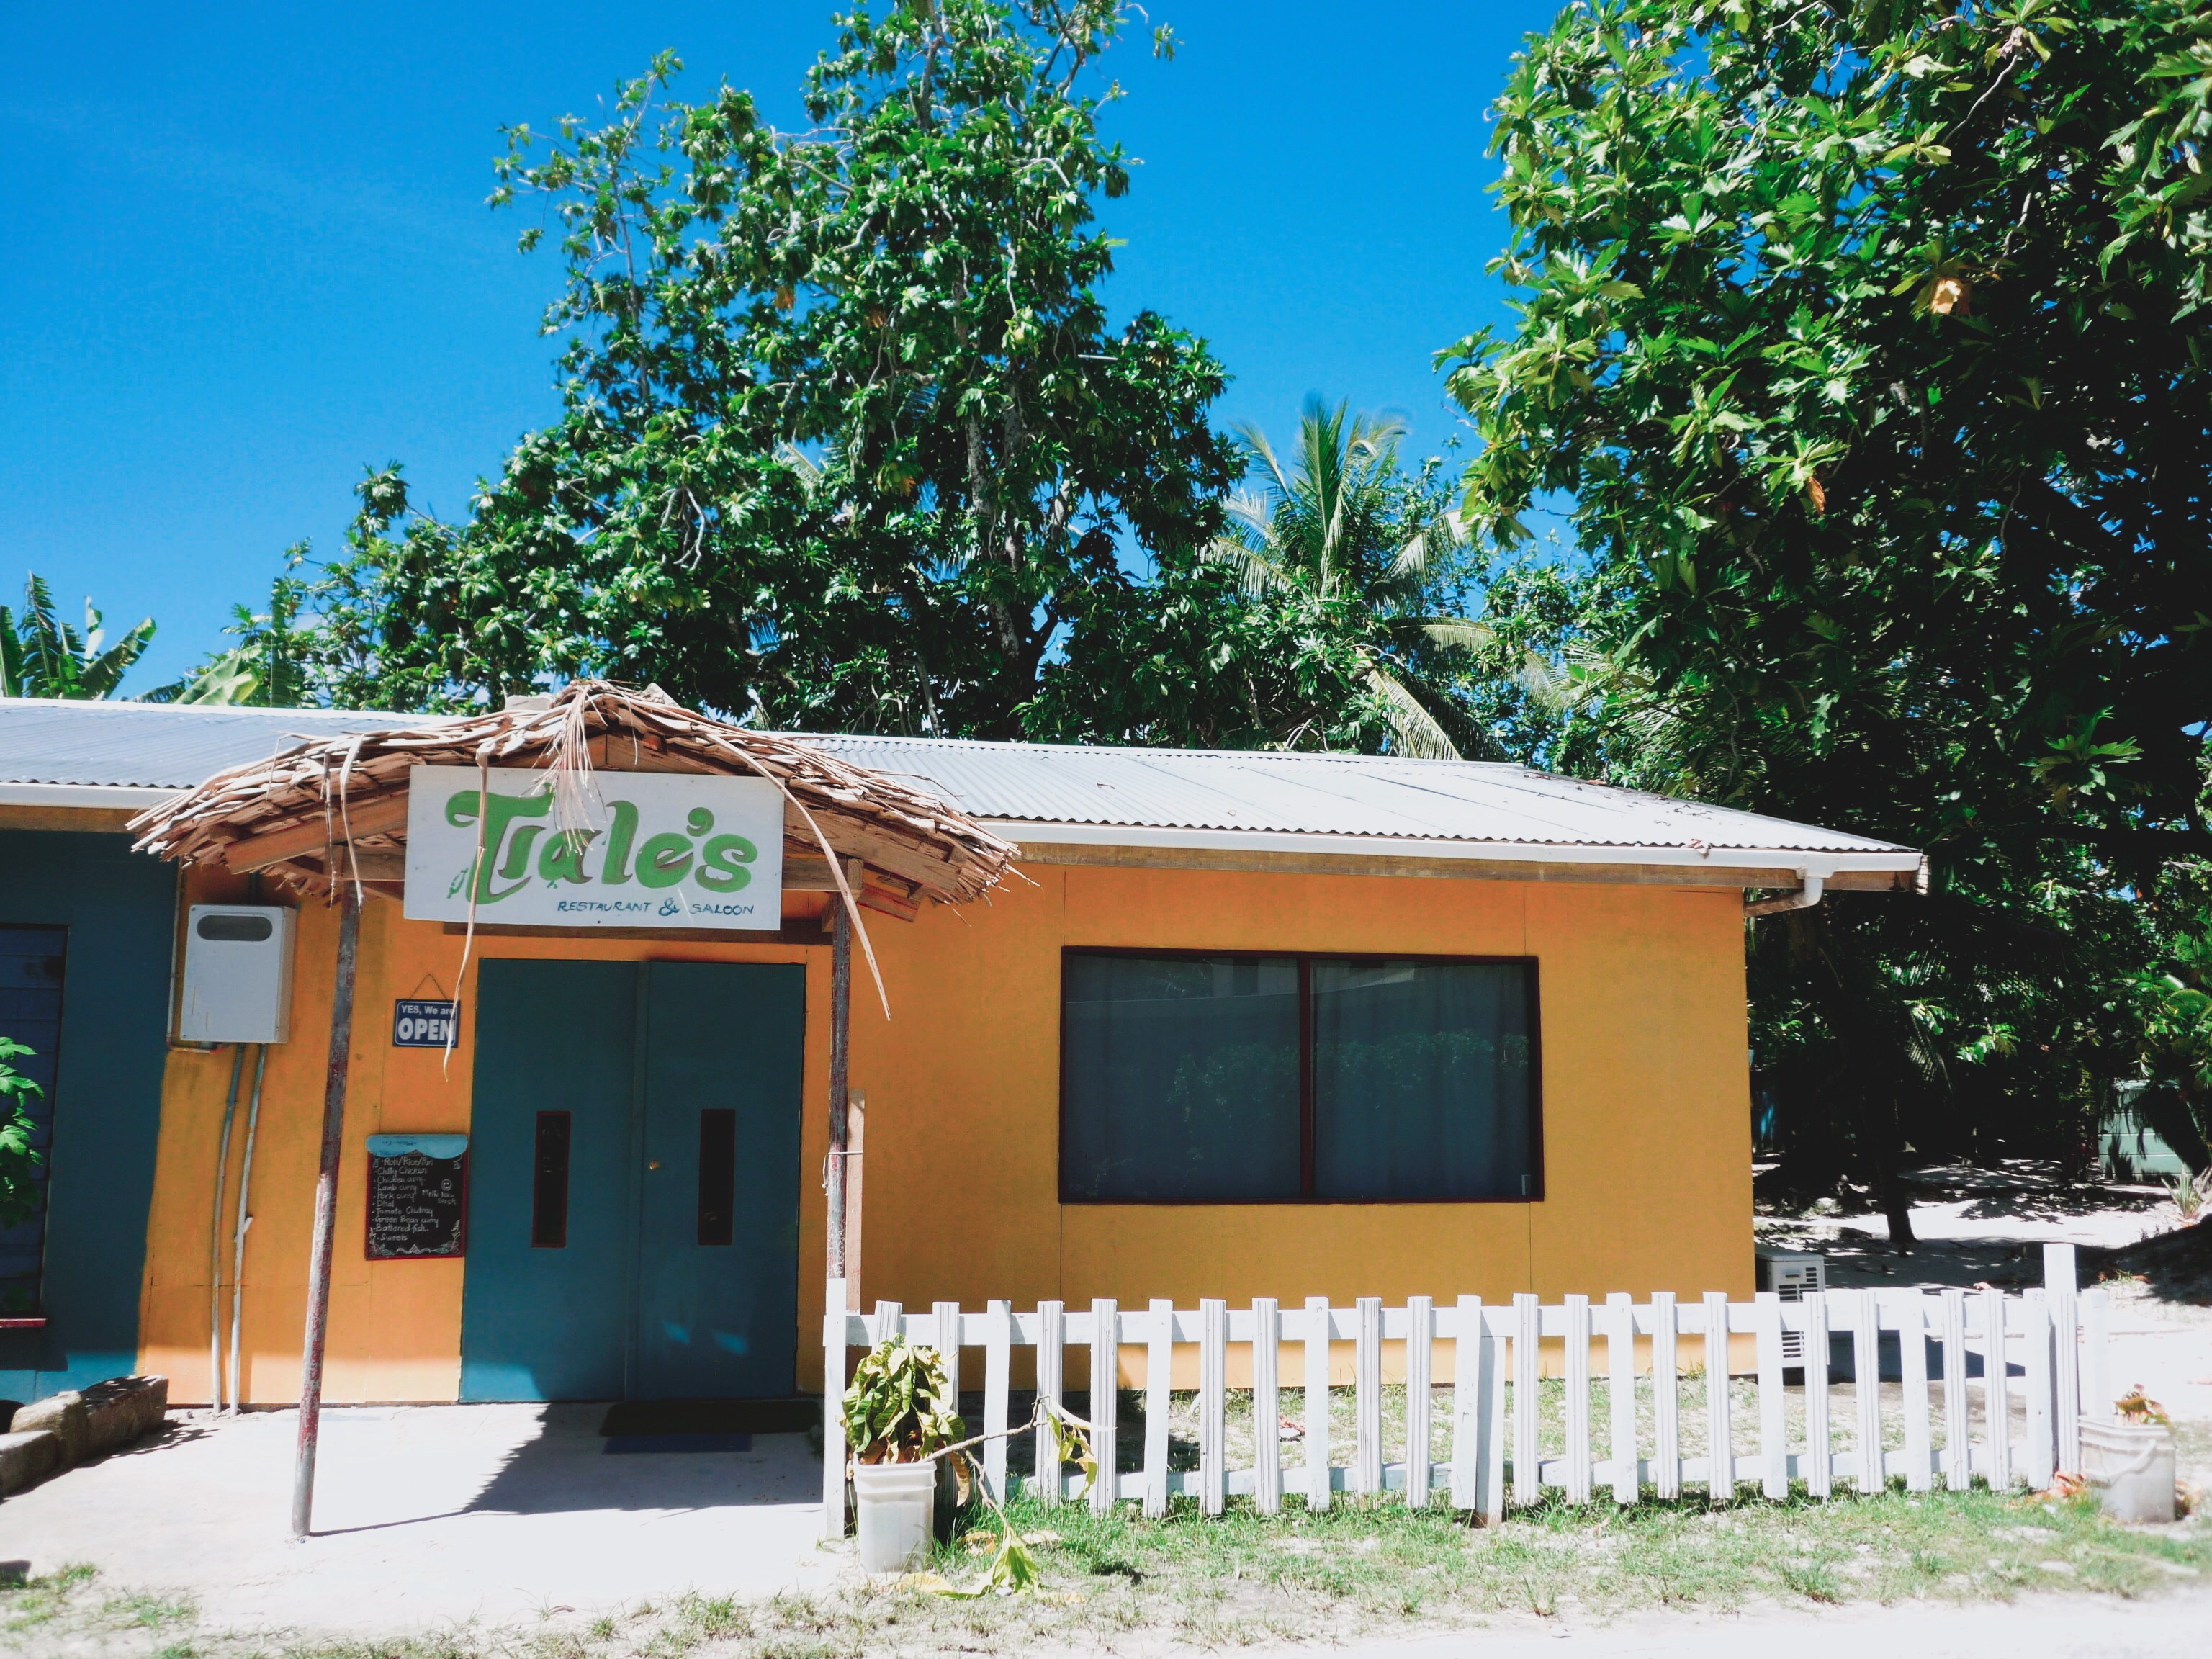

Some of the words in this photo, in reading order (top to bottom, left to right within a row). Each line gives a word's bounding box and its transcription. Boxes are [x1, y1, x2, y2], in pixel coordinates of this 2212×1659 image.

[557, 901, 652, 912] RESTAURANT
[658, 897, 681, 917] &
[688, 904, 755, 916] SALOON
[401, 1005, 422, 1015] YES,
[424, 1006, 439, 1015] We
[397, 1017, 455, 1040] OPEN
[398, 1185, 417, 1195] curry
[396, 1192, 415, 1203] curry
[405, 1205, 433, 1217] Chutney
[376, 1223, 410, 1232] Battered
[421, 1218, 439, 1228] curry
